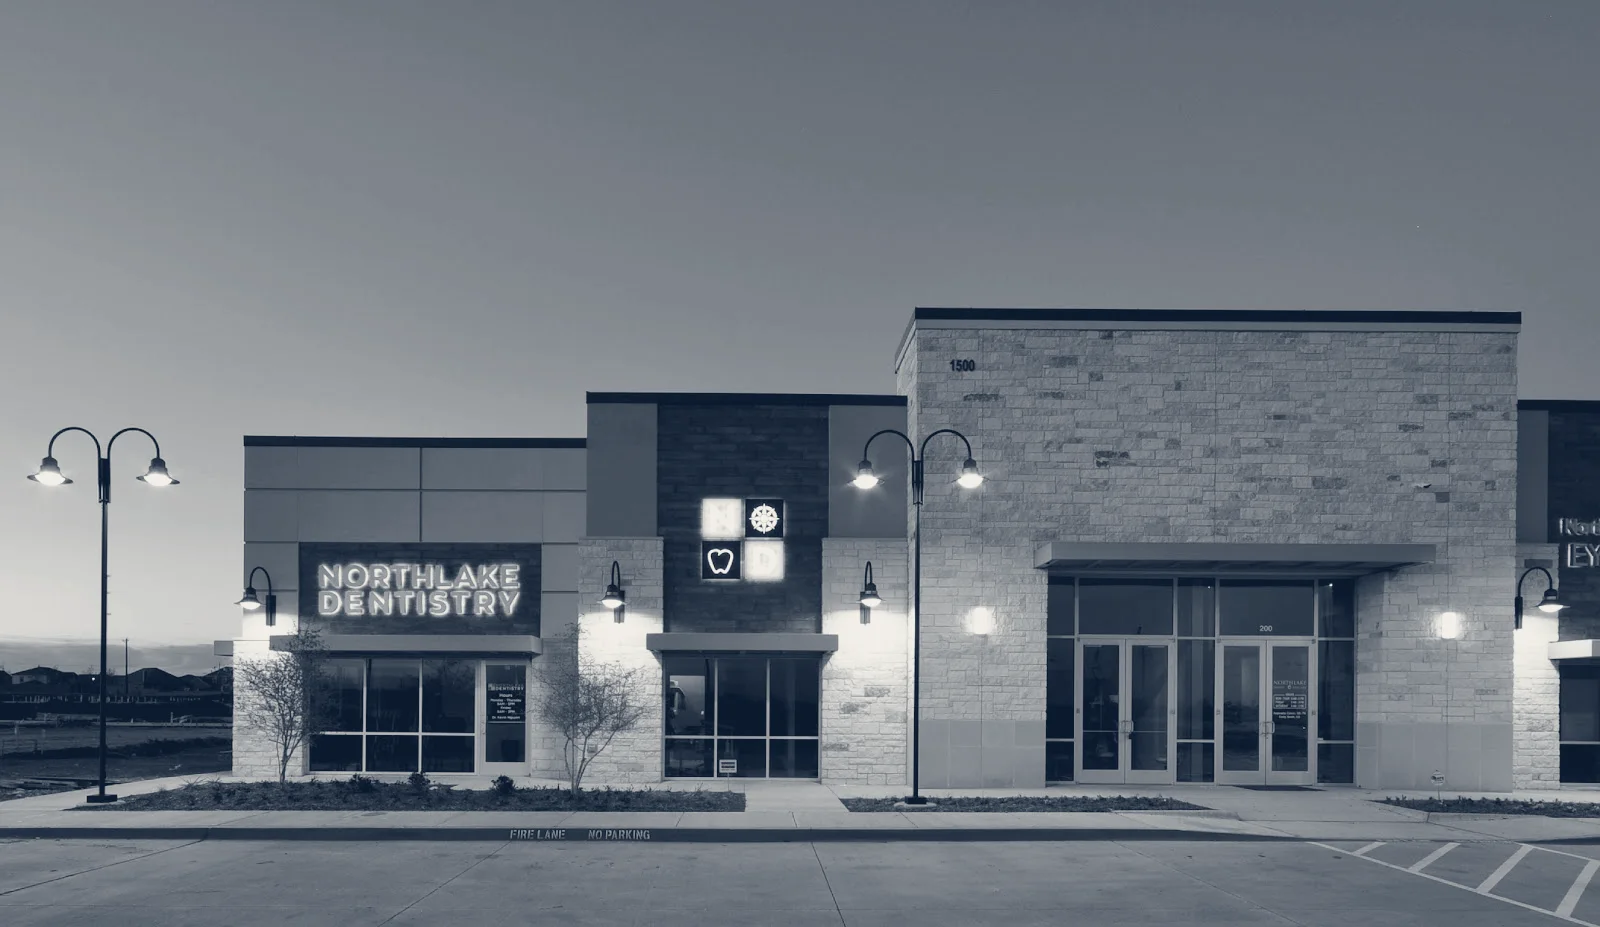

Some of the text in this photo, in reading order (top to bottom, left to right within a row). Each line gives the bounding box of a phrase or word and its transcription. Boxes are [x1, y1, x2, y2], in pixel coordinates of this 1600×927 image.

[950, 359, 975, 372] 1500
[318, 563, 520, 589] NORTHLAKE
[317, 590, 520, 616] DENTISTRY
[510, 829, 651, 840] FIRE LANE NO PARKING
